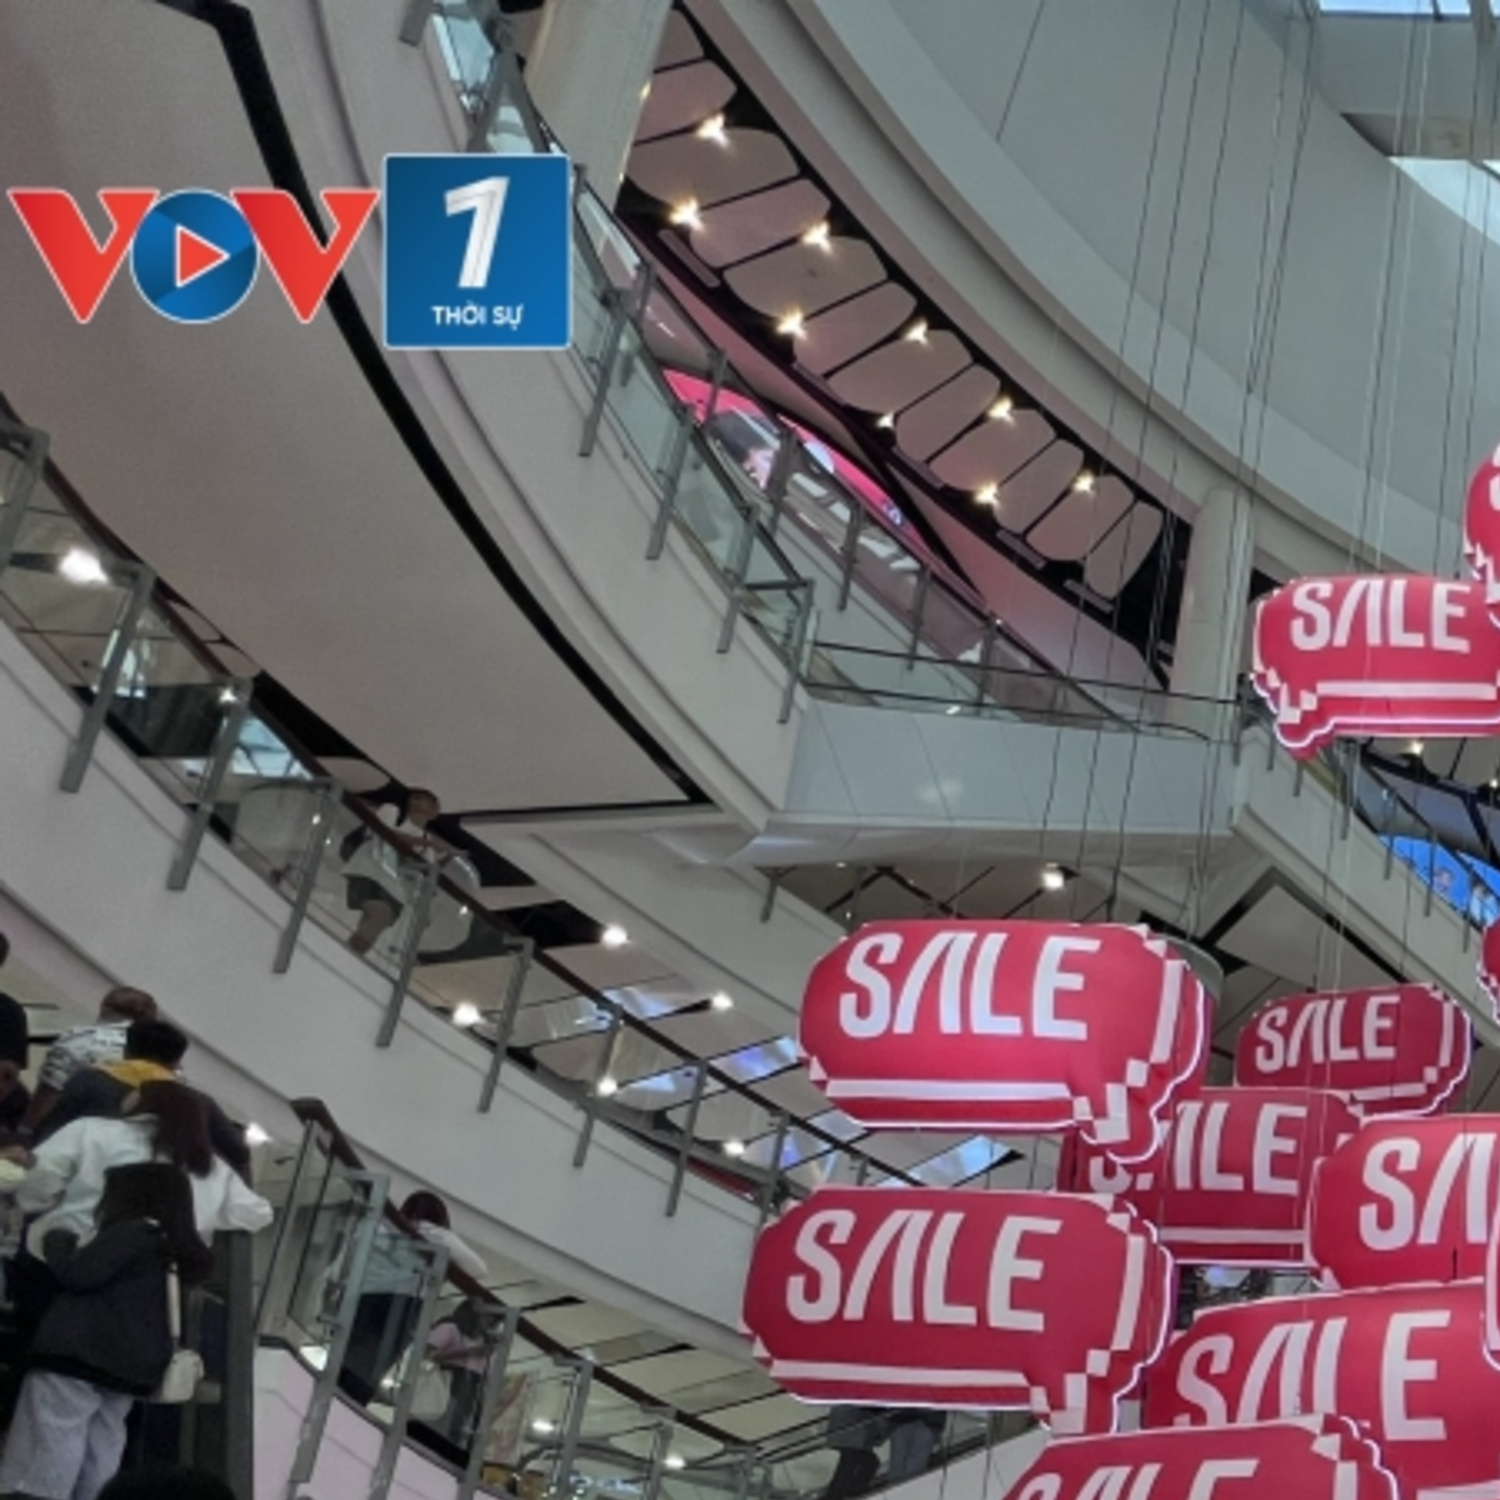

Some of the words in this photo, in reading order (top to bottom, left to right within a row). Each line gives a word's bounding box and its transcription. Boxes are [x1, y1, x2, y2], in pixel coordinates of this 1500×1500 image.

[1290, 579, 1472, 653] SALE
[838, 932, 1101, 1040] SALE
[1255, 995, 1400, 1072] SALE
[786, 1209, 1063, 1332] SALE
